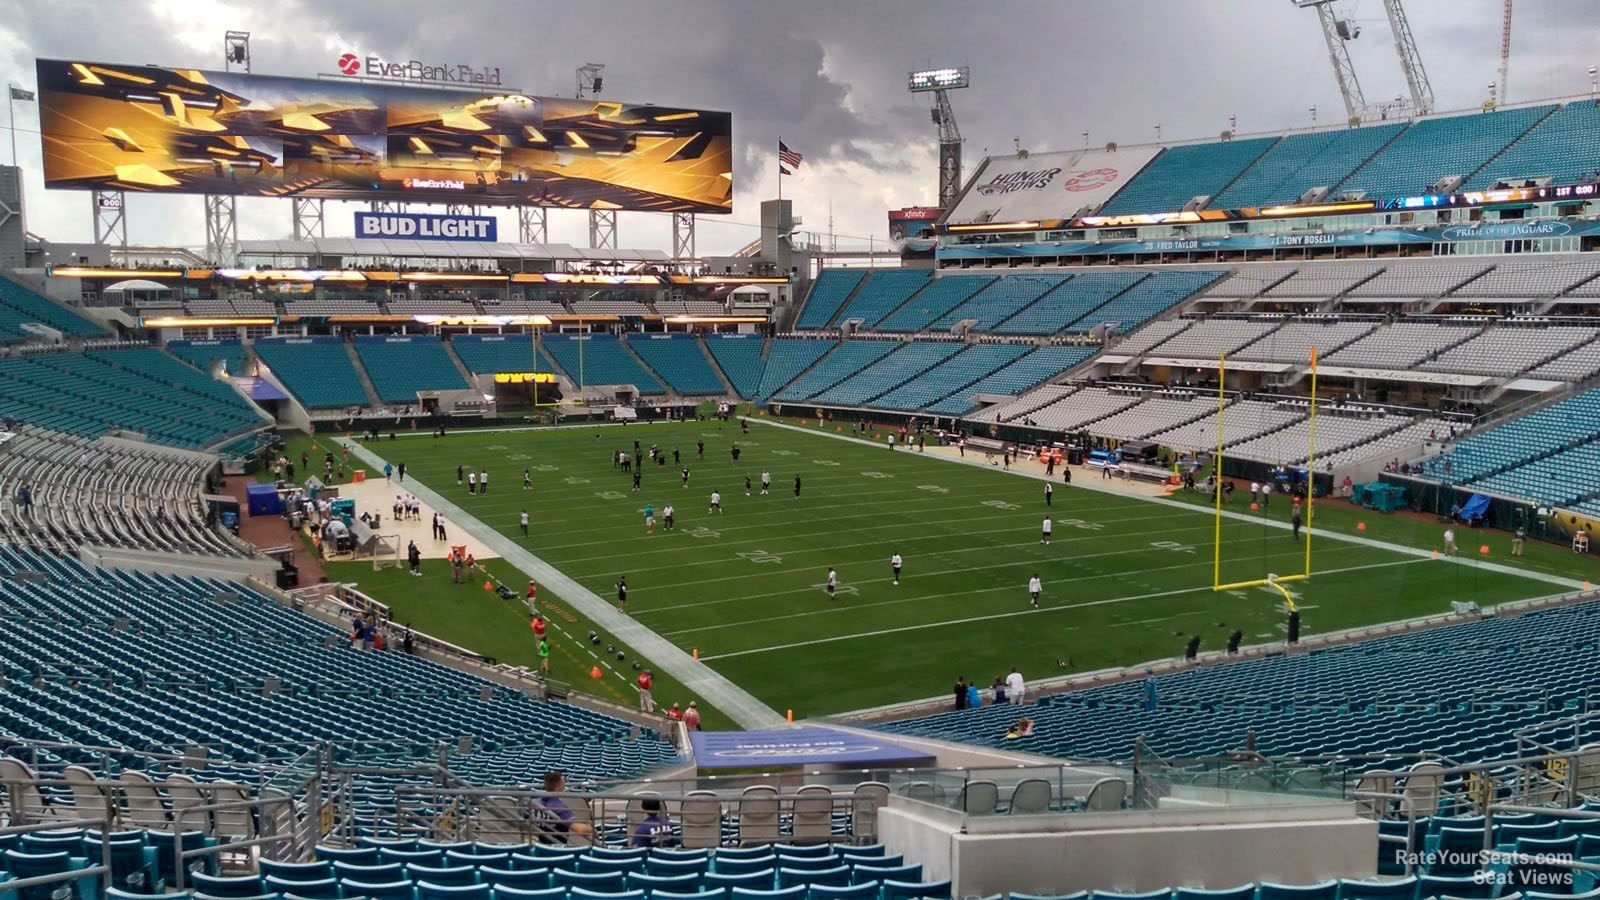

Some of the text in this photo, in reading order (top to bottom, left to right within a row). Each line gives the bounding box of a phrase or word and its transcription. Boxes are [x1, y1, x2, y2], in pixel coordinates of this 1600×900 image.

[366, 56, 501, 85] EverBank Field
[1557, 187, 1571, 196] 1ST
[1576, 185, 1593, 195] 0:00
[363, 216, 490, 238] BUD LIGHT
[1456, 228, 1482, 237] PRIDE
[1512, 224, 1553, 236] JAGUARS
[1157, 241, 1173, 250] FRED
[1175, 240, 1198, 249] TAYLOR
[1283, 236, 1302, 245] TONY
[1304, 234, 1334, 245] BOSELLI
